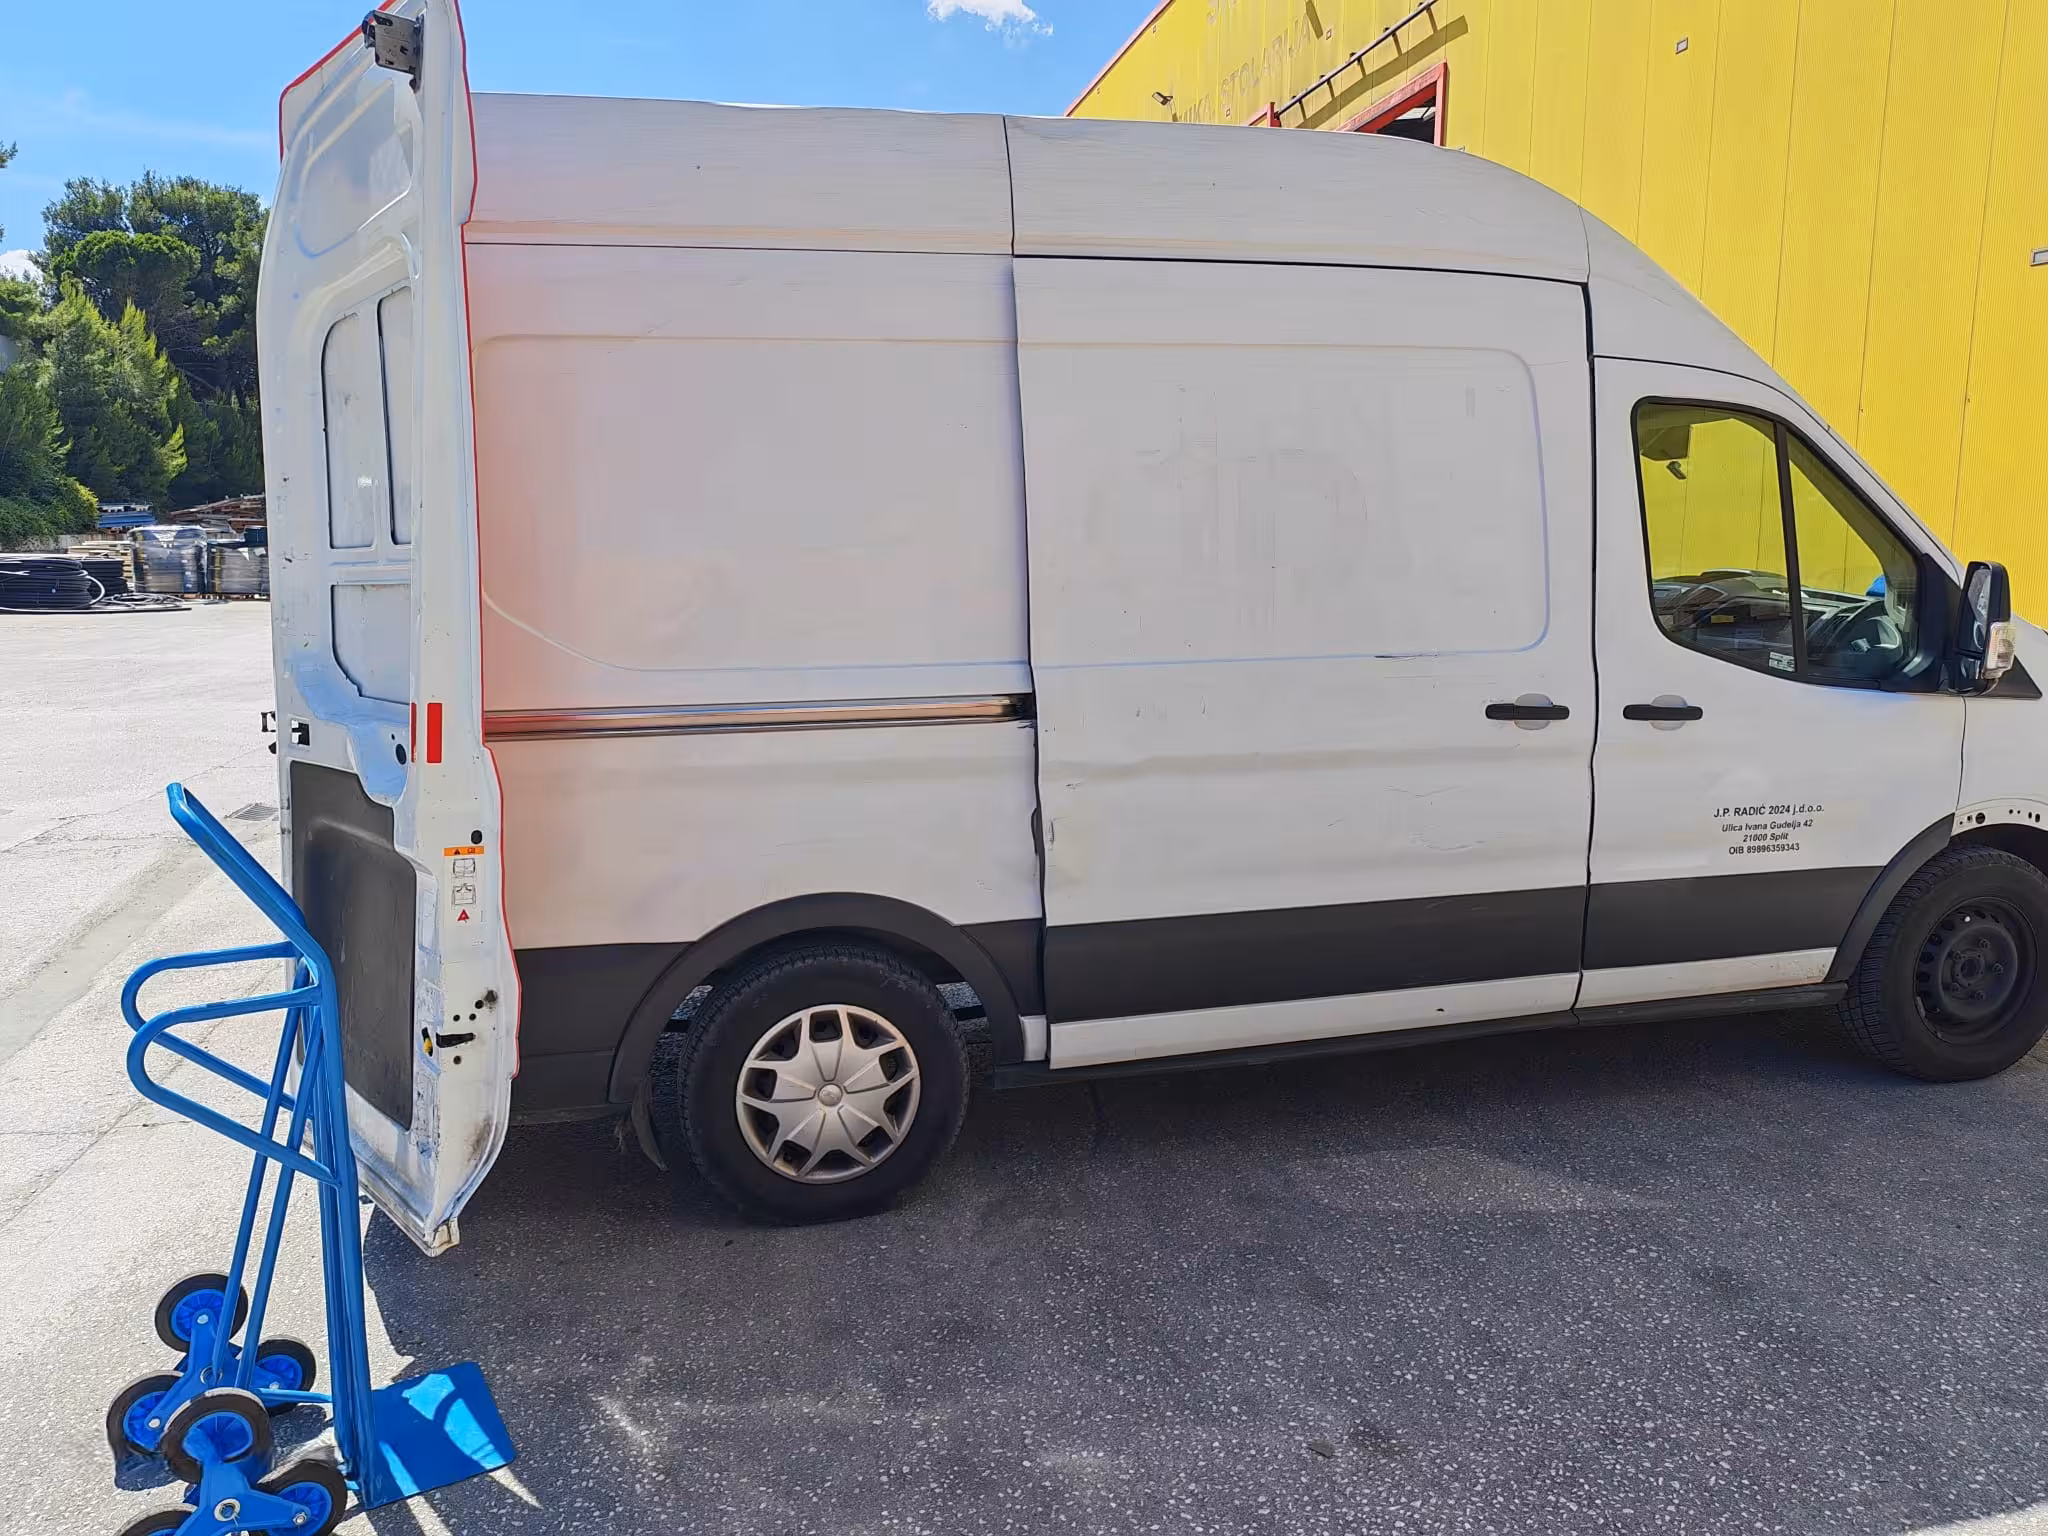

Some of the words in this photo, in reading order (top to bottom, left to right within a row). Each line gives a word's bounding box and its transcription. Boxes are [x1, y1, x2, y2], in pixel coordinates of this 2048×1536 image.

[1714, 808, 1730, 818] J.P.
[1733, 804, 1766, 817] RADIĆ
[1768, 804, 1791, 815] 2024
[1792, 804, 1824, 815] j.d.o.o.
[1722, 823, 1743, 832] Ulica
[1745, 823, 1767, 831] Ivana
[1770, 820, 1801, 830] Gudelja
[1803, 819, 1813, 827] 42
[1743, 833, 1768, 843] 21000
[1769, 832, 1788, 841] Split
[1728, 845, 1745, 855] OIB
